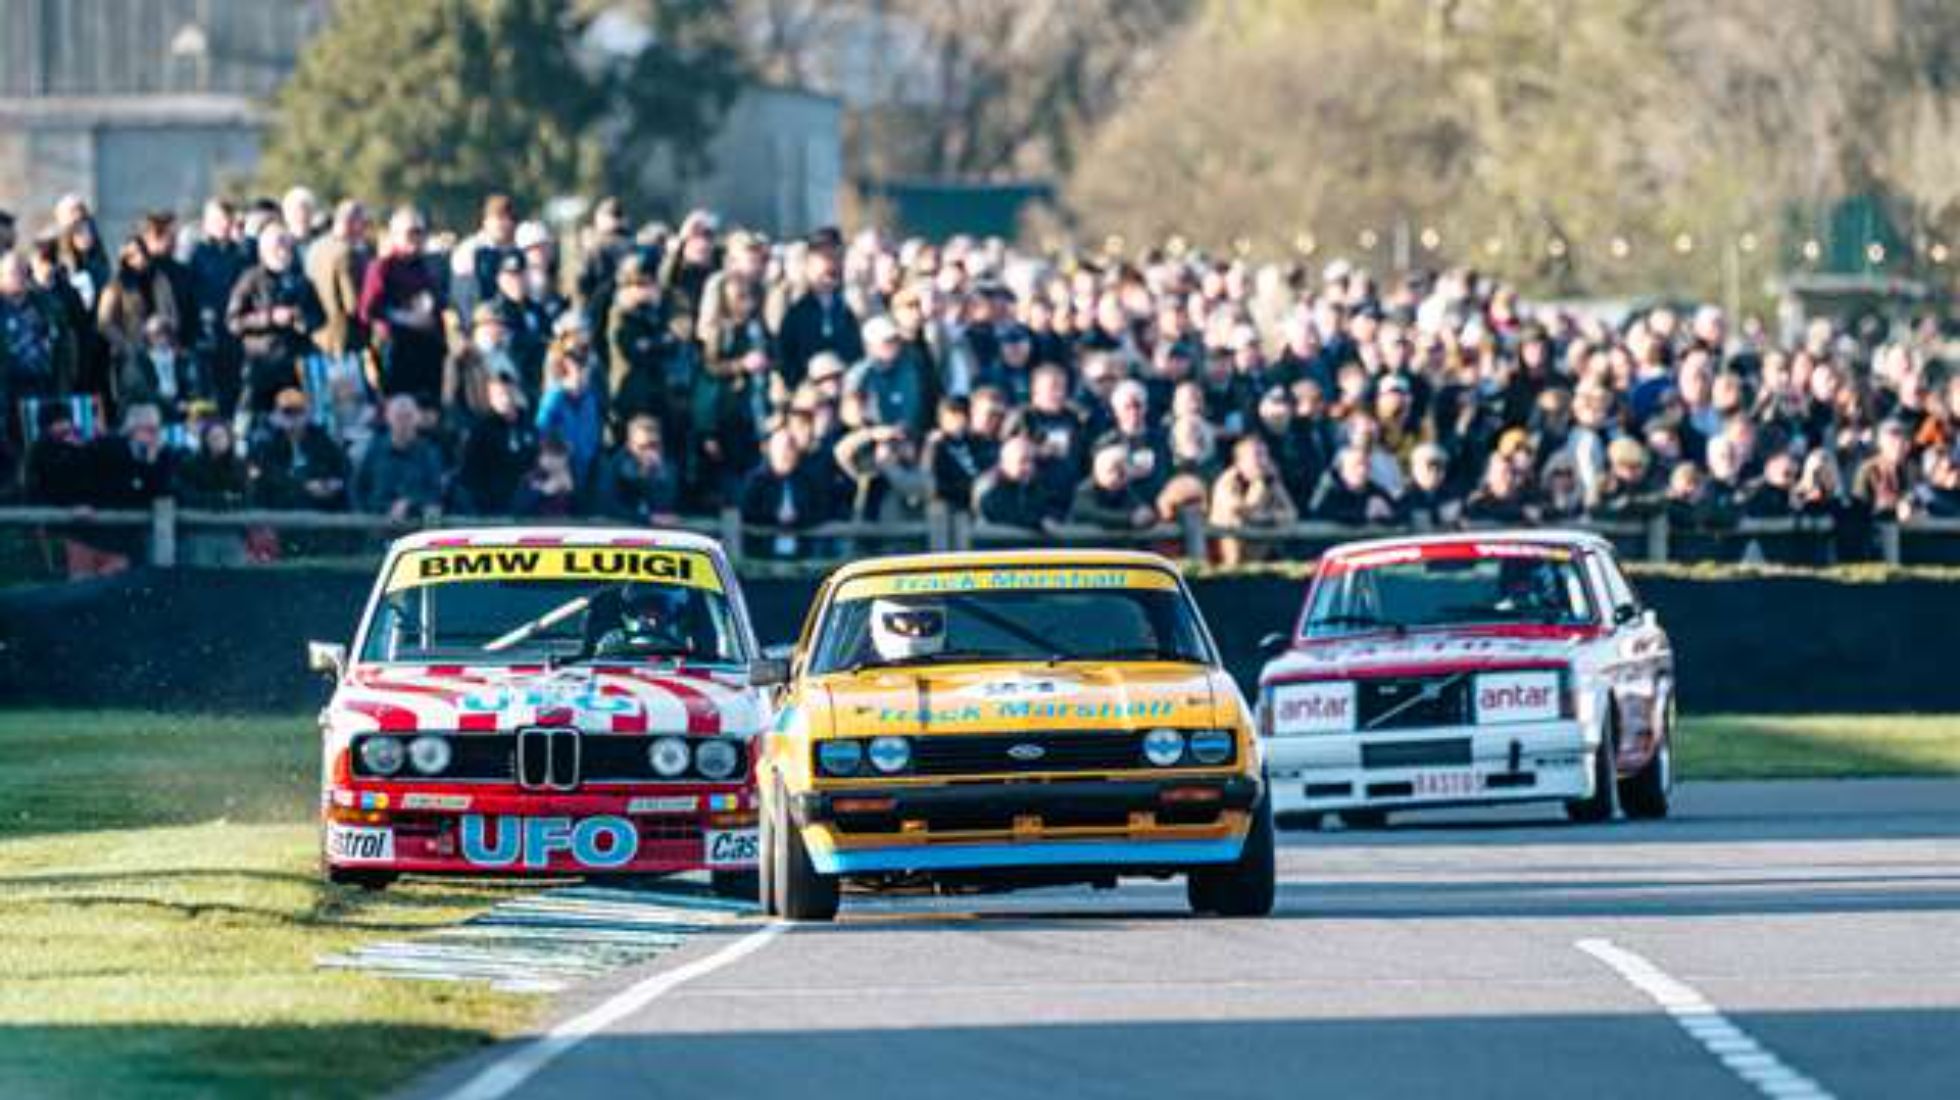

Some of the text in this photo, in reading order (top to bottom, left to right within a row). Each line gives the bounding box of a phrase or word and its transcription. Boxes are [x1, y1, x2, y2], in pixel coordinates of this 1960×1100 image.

[420, 553, 693, 580] BMW LUIGI
[997, 699, 1175, 719] Marshall
[1279, 694, 1349, 721] antar
[1480, 683, 1550, 711] antar
[460, 813, 639, 867] UFO
[712, 832, 759, 860] Cas
